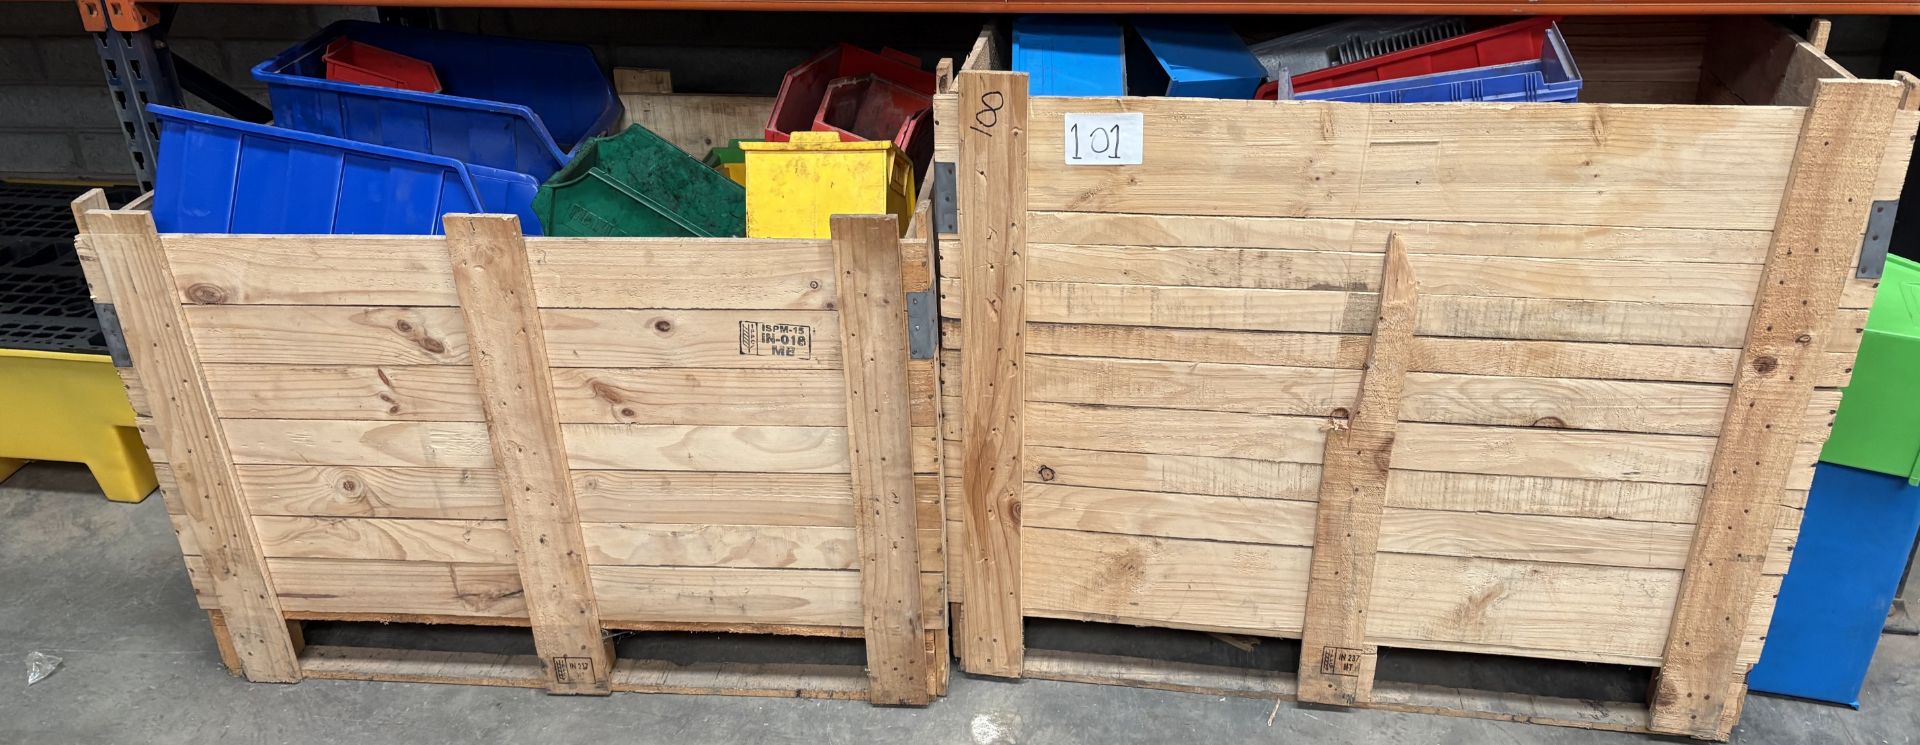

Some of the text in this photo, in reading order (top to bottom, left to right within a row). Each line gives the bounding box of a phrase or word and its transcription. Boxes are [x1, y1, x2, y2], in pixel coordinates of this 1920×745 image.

[970, 91, 1004, 137] 100
[1071, 123, 1121, 160] 101
[761, 324, 804, 334] ISPM-15
[761, 333, 806, 346] IN-018
[1338, 653, 1360, 662] IN 237
